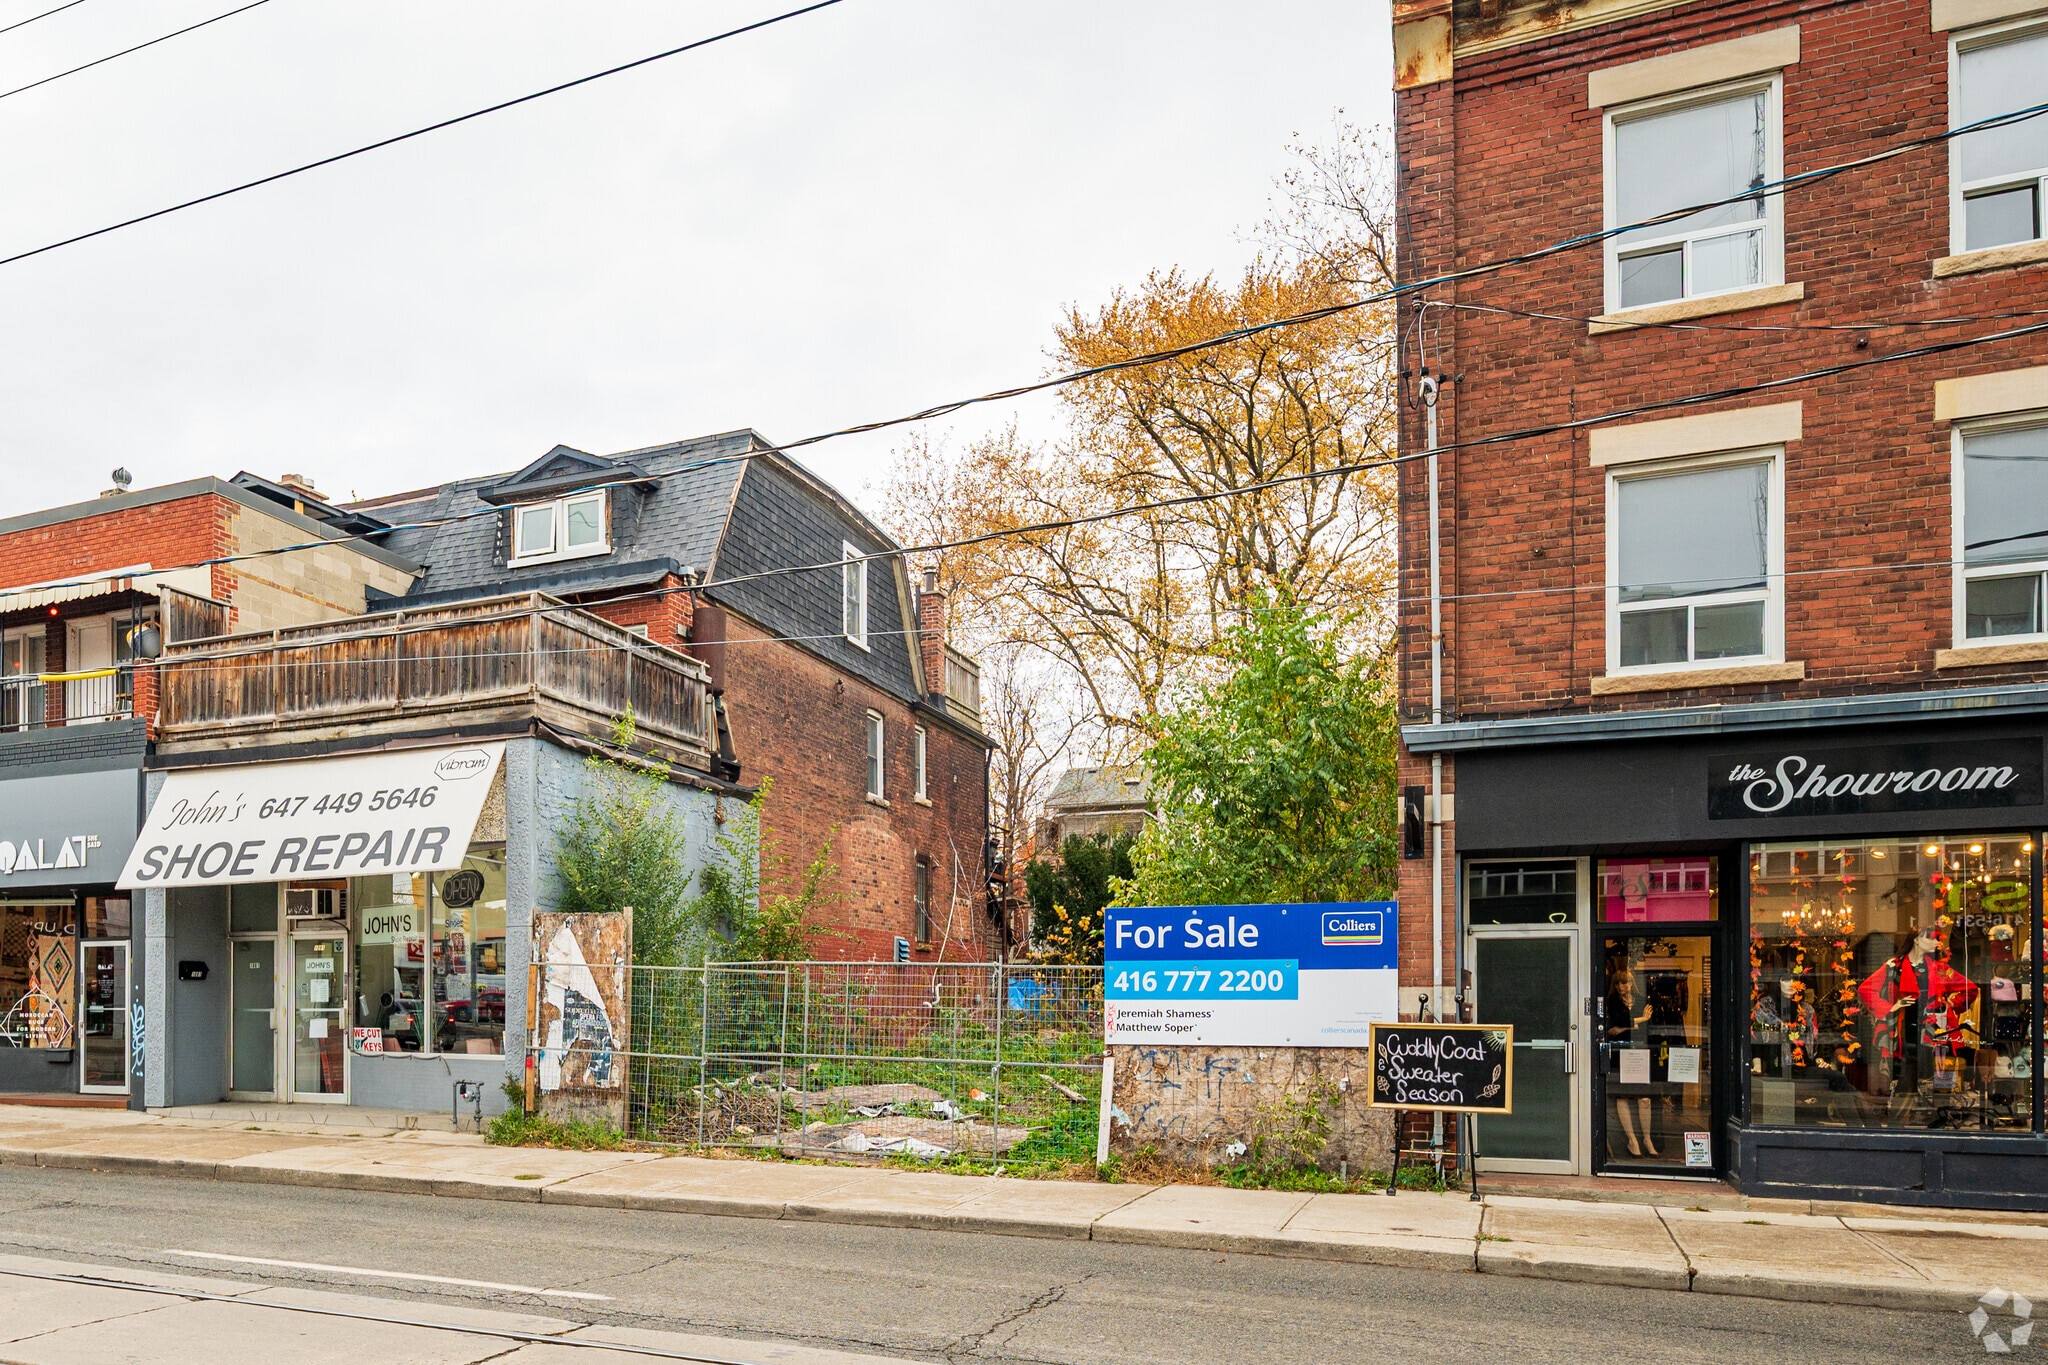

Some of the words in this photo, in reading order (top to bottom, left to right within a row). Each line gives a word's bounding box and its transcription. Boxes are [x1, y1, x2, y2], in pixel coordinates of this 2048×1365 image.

[440, 758, 486, 770] vibram
[1729, 764, 1766, 781] the
[1743, 755, 2019, 812] Showroom
[162, 790, 246, 830] John's
[259, 796, 309, 819] 647
[313, 791, 363, 814] 449
[368, 785, 438, 811] 5646
[136, 840, 266, 880] SHOE
[270, 826, 450, 874] REPAIR
[444, 878, 476, 900] OPEN
[364, 914, 412, 935] JOHN'S
[1115, 919, 1172, 948] For
[1184, 916, 1259, 948] Sale
[1328, 919, 1376, 932] Colliers
[307, 961, 331, 970] JOHN'S
[1113, 970, 1158, 992] 416
[1164, 970, 1212, 992] 777
[1219, 970, 1284, 992] 2200
[1116, 1009, 1163, 1020] Jeremiah
[354, 1029, 364, 1038] WE
[367, 1029, 381, 1038] CUT
[1116, 1023, 1162, 1032] Matthew
[364, 1042, 383, 1051] KEYS
[1388, 1055, 1463, 1086] Sweater
[1395, 1079, 1463, 1103] Season
